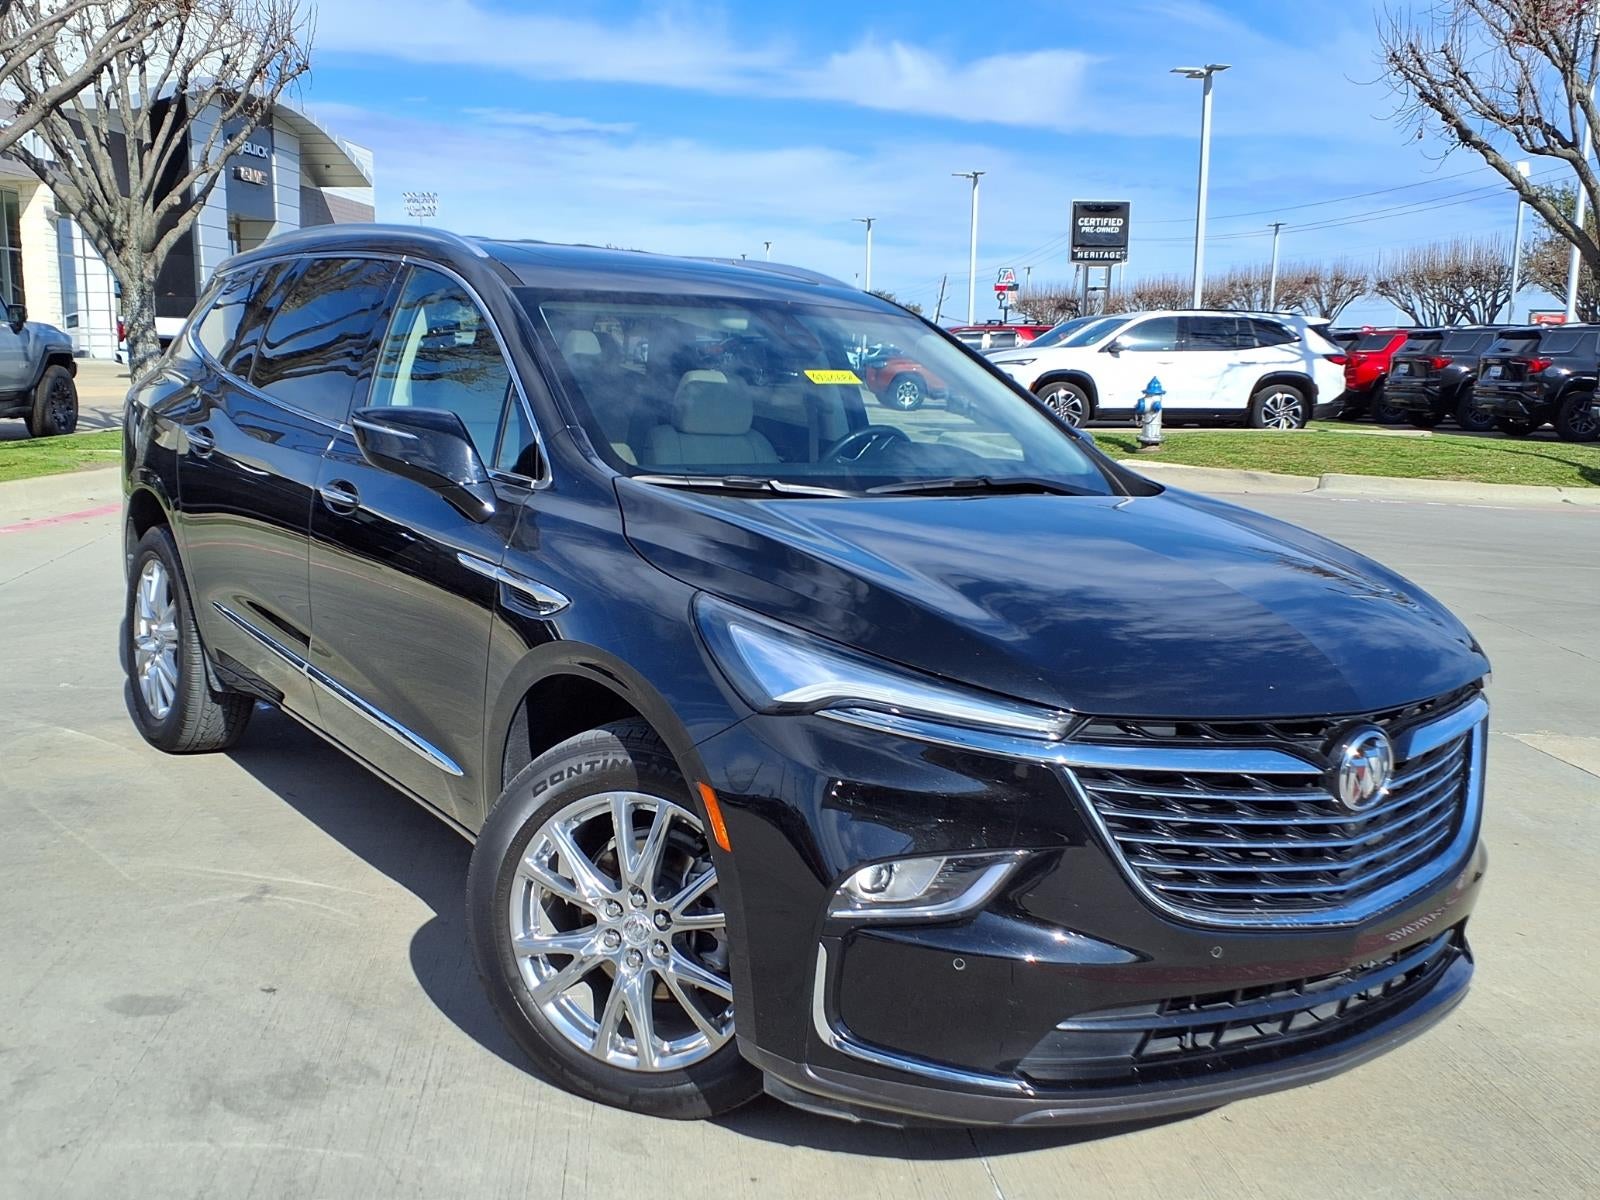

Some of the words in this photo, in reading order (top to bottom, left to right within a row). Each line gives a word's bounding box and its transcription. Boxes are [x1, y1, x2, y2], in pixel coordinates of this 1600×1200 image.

[244, 141, 268, 158] BUICK
[1078, 217, 1123, 226] CERTIFIED
[1077, 251, 1121, 259] HERITAGE
[532, 758, 682, 798] CONTIN
